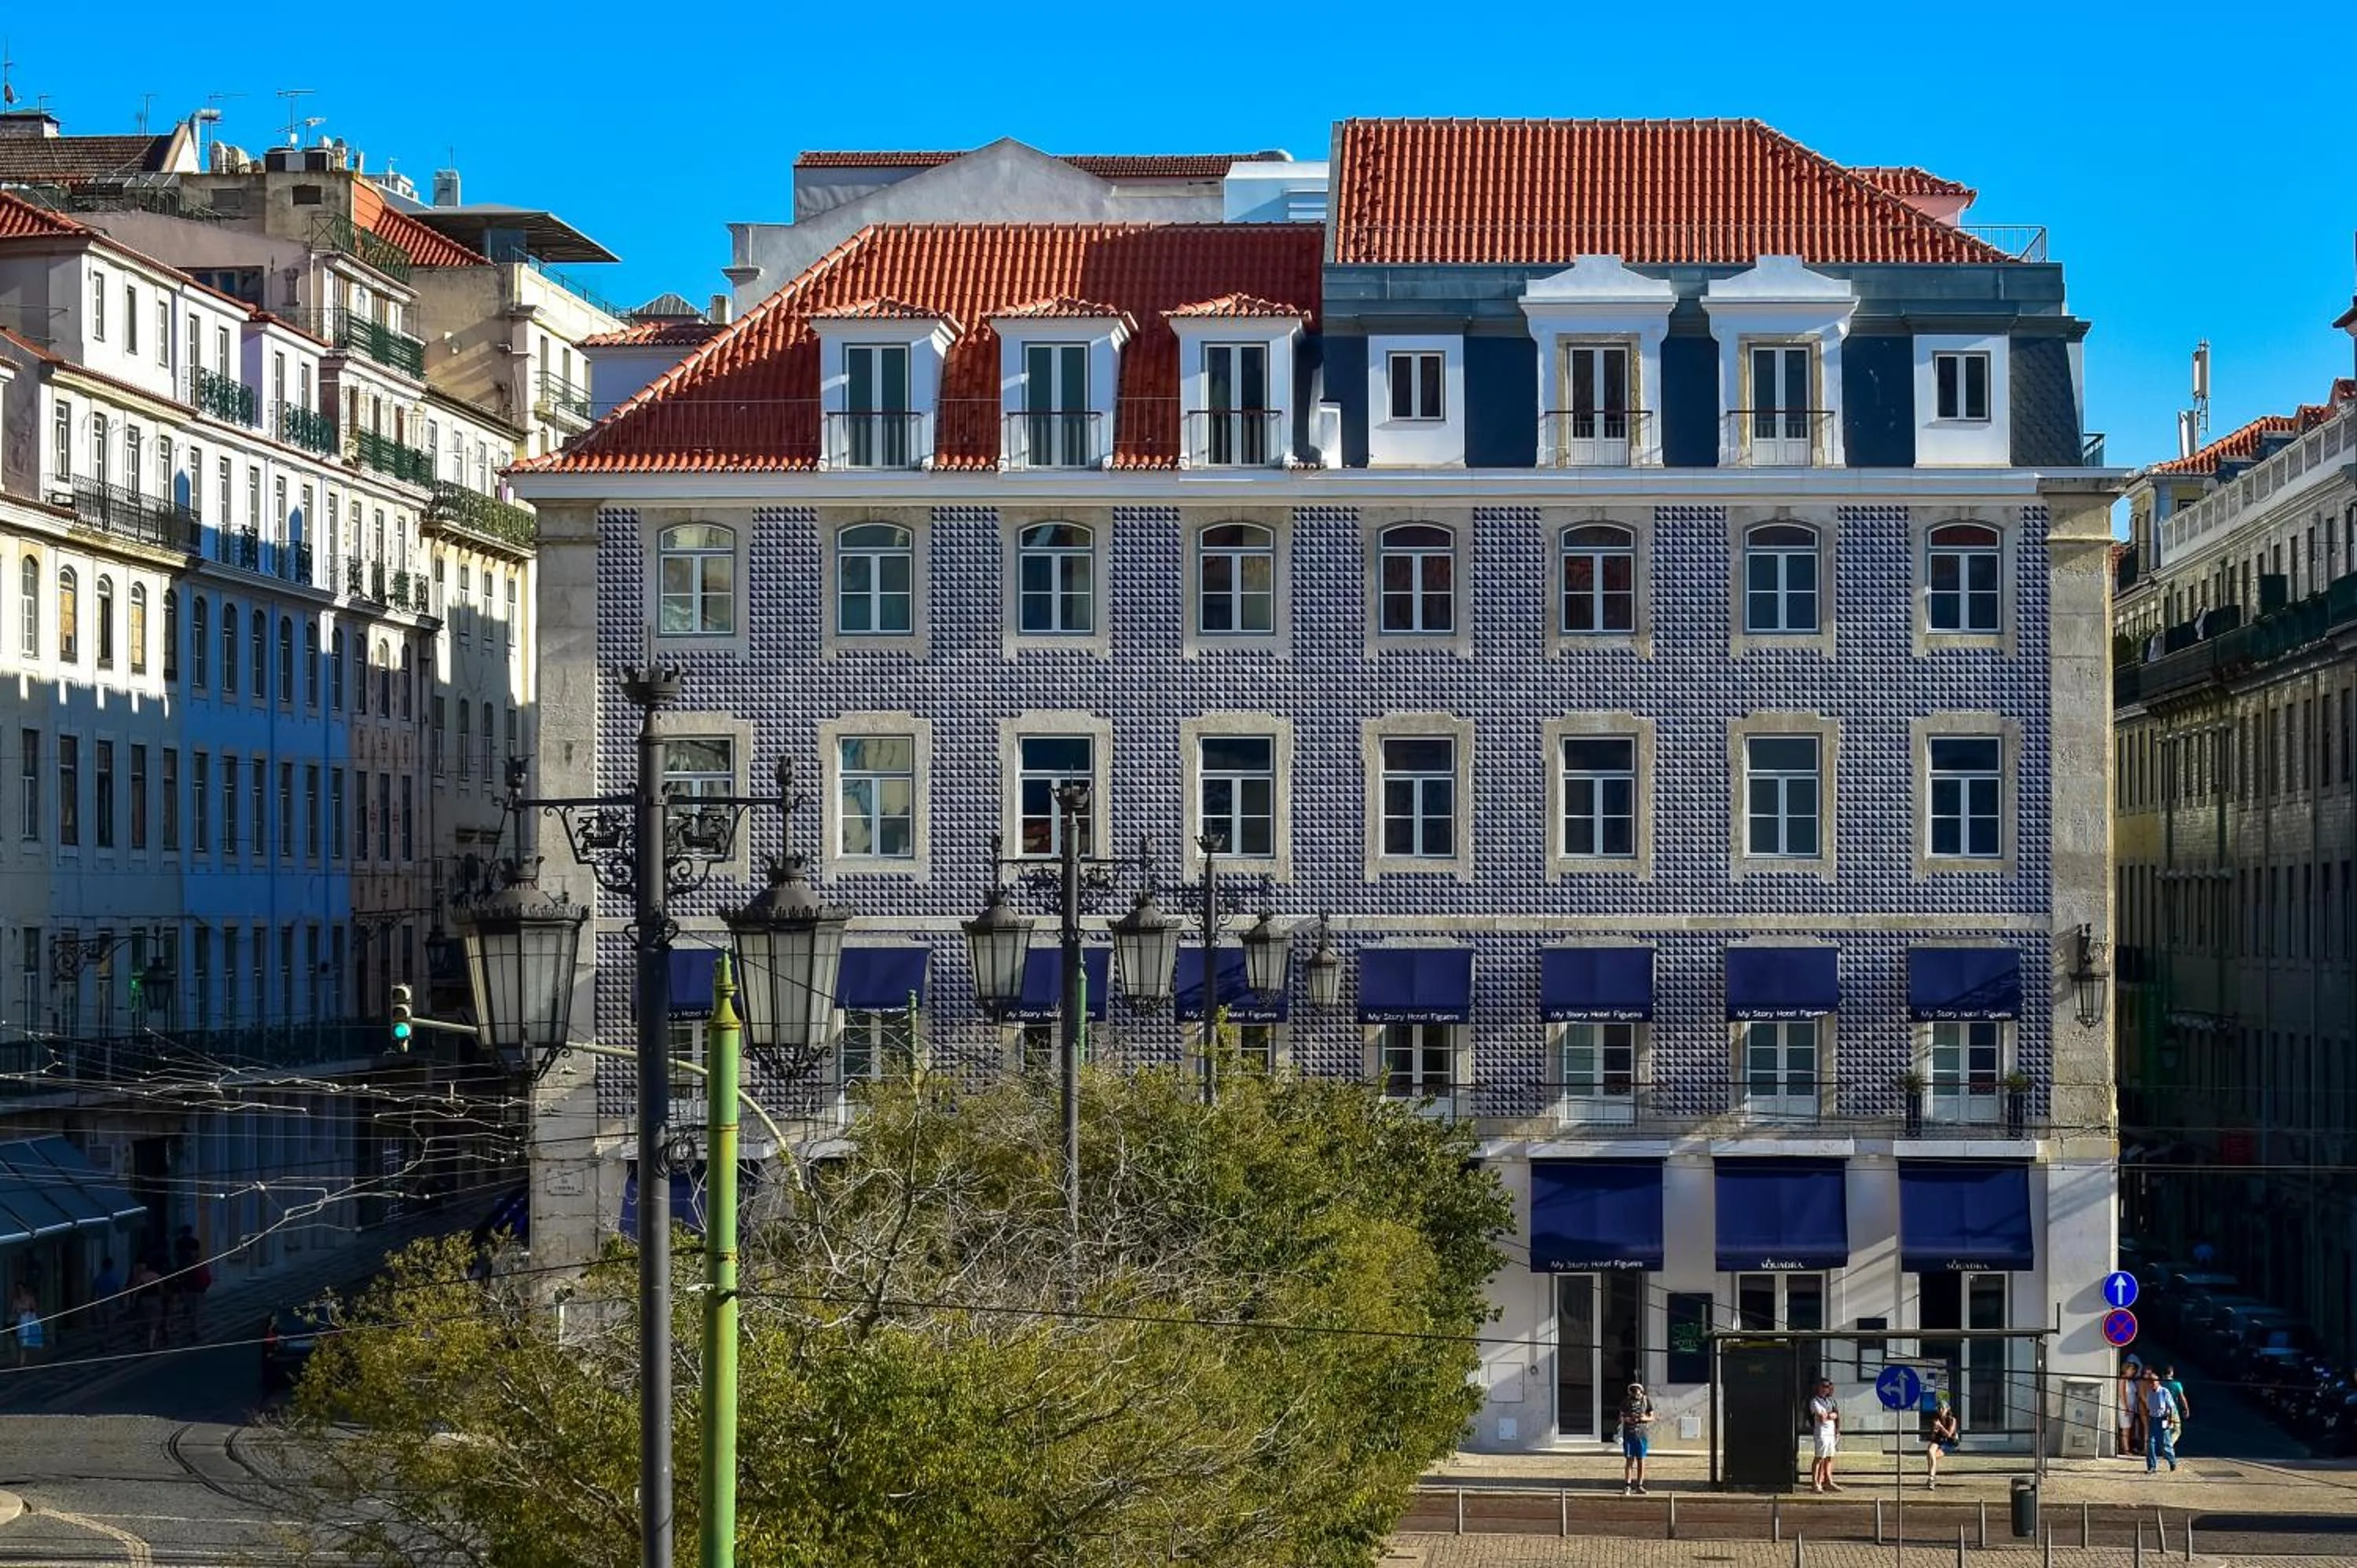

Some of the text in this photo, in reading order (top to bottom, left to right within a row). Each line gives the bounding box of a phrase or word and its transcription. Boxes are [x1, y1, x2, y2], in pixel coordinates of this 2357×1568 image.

[1019, 1010, 1041, 1019] Story
[1368, 1013, 1380, 1021] My
[1384, 1013, 1405, 1021] Story
[1550, 1010, 1563, 1020] My
[1567, 1010, 1588, 1020] Story
[1590, 1010, 1610, 1019] Hotel
[1736, 1009, 1750, 1018] My
[1752, 1009, 1774, 1018] Story
[1921, 1009, 1933, 1019] My
[1937, 1009, 1957, 1019] Story
[1960, 1009, 1980, 1018] Hotel
[1550, 1261, 1563, 1269] My
[1591, 1260, 1611, 1269] Hotel
[1761, 1259, 1805, 1269] SQUADRA
[1946, 1261, 1990, 1269] SQUADRA
